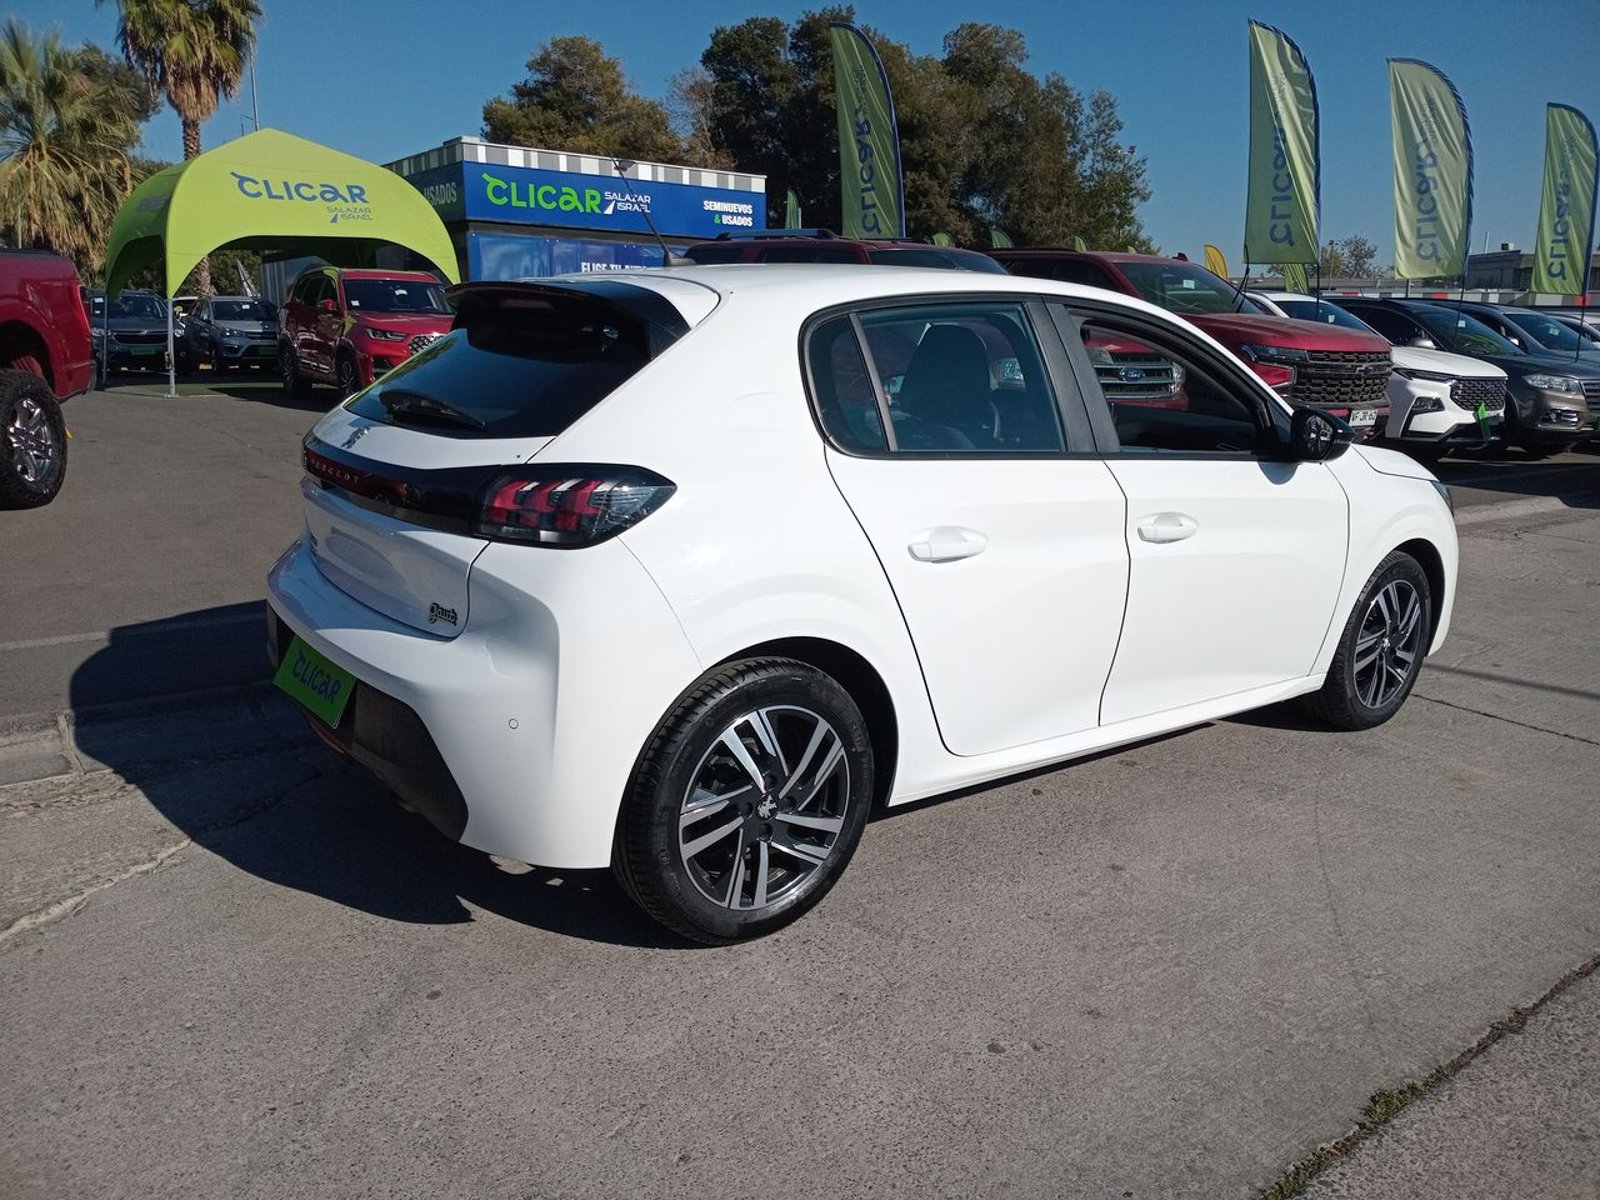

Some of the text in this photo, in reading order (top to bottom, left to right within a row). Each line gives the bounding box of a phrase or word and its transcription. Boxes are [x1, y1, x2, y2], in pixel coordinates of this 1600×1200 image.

[604, 191, 651, 204] SALAZAR
[326, 206, 371, 214] SALAZAR
[617, 202, 651, 213] ISRAEL
[703, 200, 753, 214] SEMINUEVOS
[714, 214, 753, 227] & USADOS
